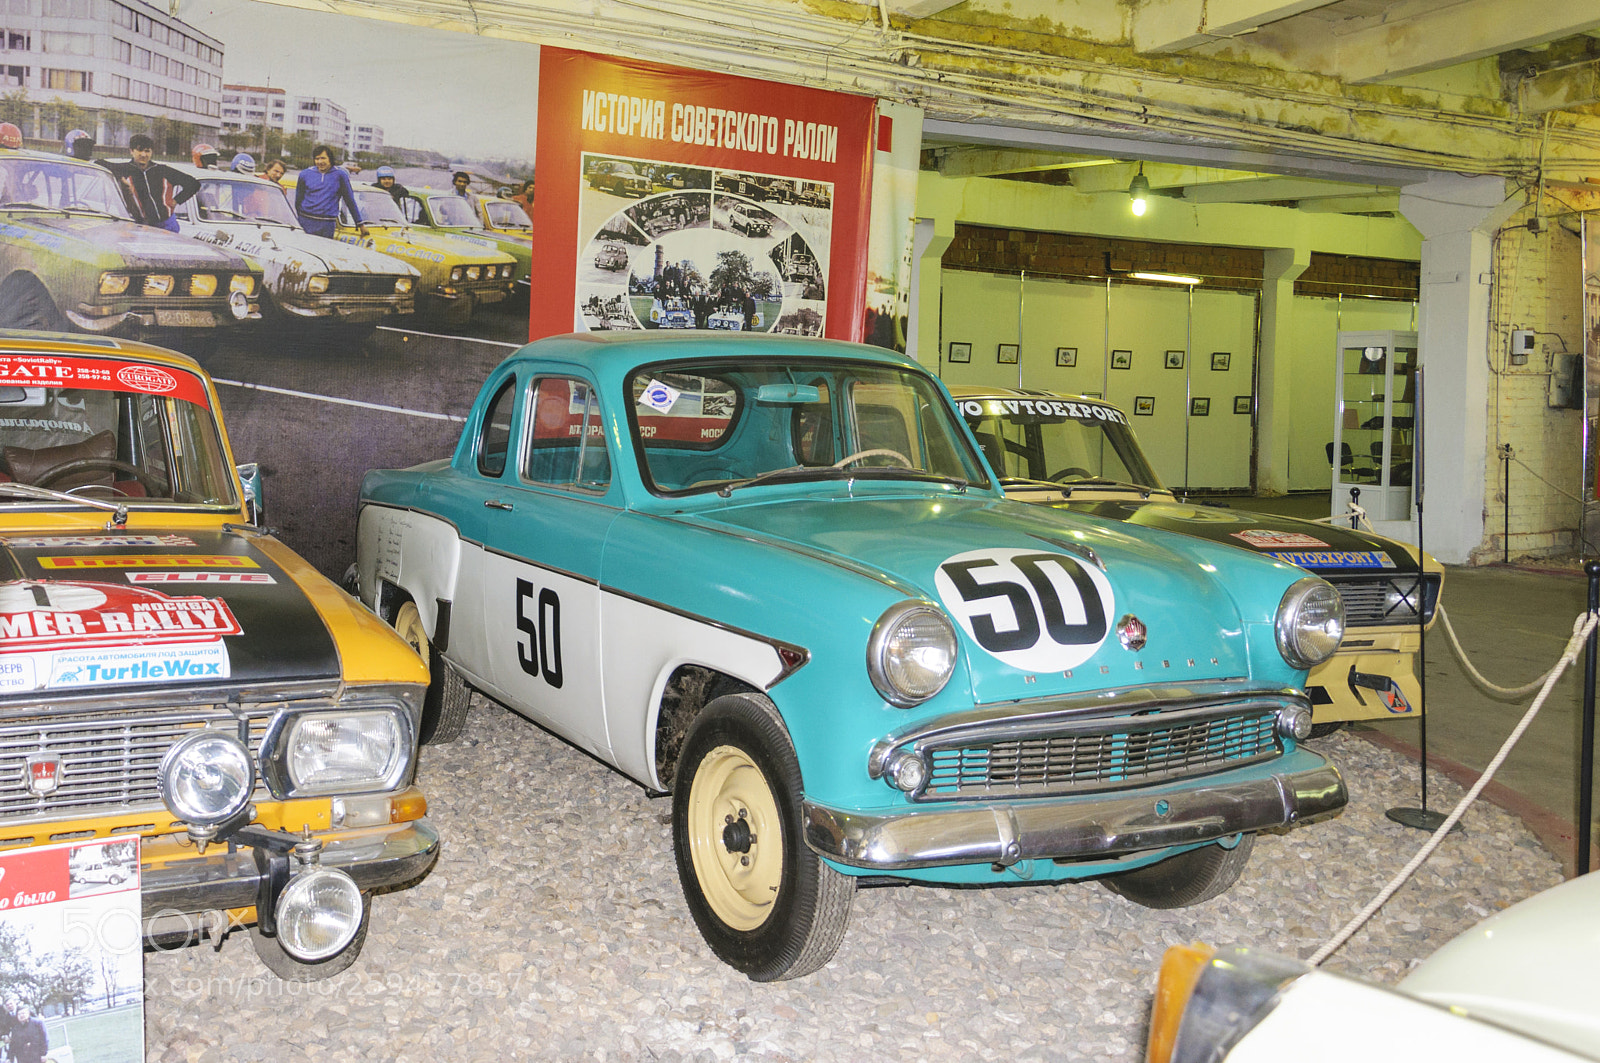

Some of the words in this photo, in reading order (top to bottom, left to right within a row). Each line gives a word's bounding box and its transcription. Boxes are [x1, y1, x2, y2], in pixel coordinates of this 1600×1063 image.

[581, 89, 666, 140] ИСТОРИЯ
[671, 103, 778, 155] СОВЕТСКОГО
[783, 119, 839, 164] РАЛЛИ
[120, 373, 175, 386] EUROGATE
[989, 400, 1127, 426] AVTOEXPORT
[639, 425, 657, 438] ССР
[51, 556, 244, 566] PIRELLI
[134, 573, 269, 582] ELITE
[24, 584, 52, 607] 1
[132, 601, 215, 612] МОСКВА
[941, 553, 1107, 653] 50
[0, 609, 219, 639] MER-RALLY
[516, 577, 563, 689] 50
[97, 652, 157, 662] АВТОМОБИЛЯ
[178, 648, 220, 657] ЗАЩИТОЙ
[86, 659, 221, 682] TurtleWax
[1024, 656, 1220, 684] МОСКВИЧ
[13, 890, 56, 907] было
